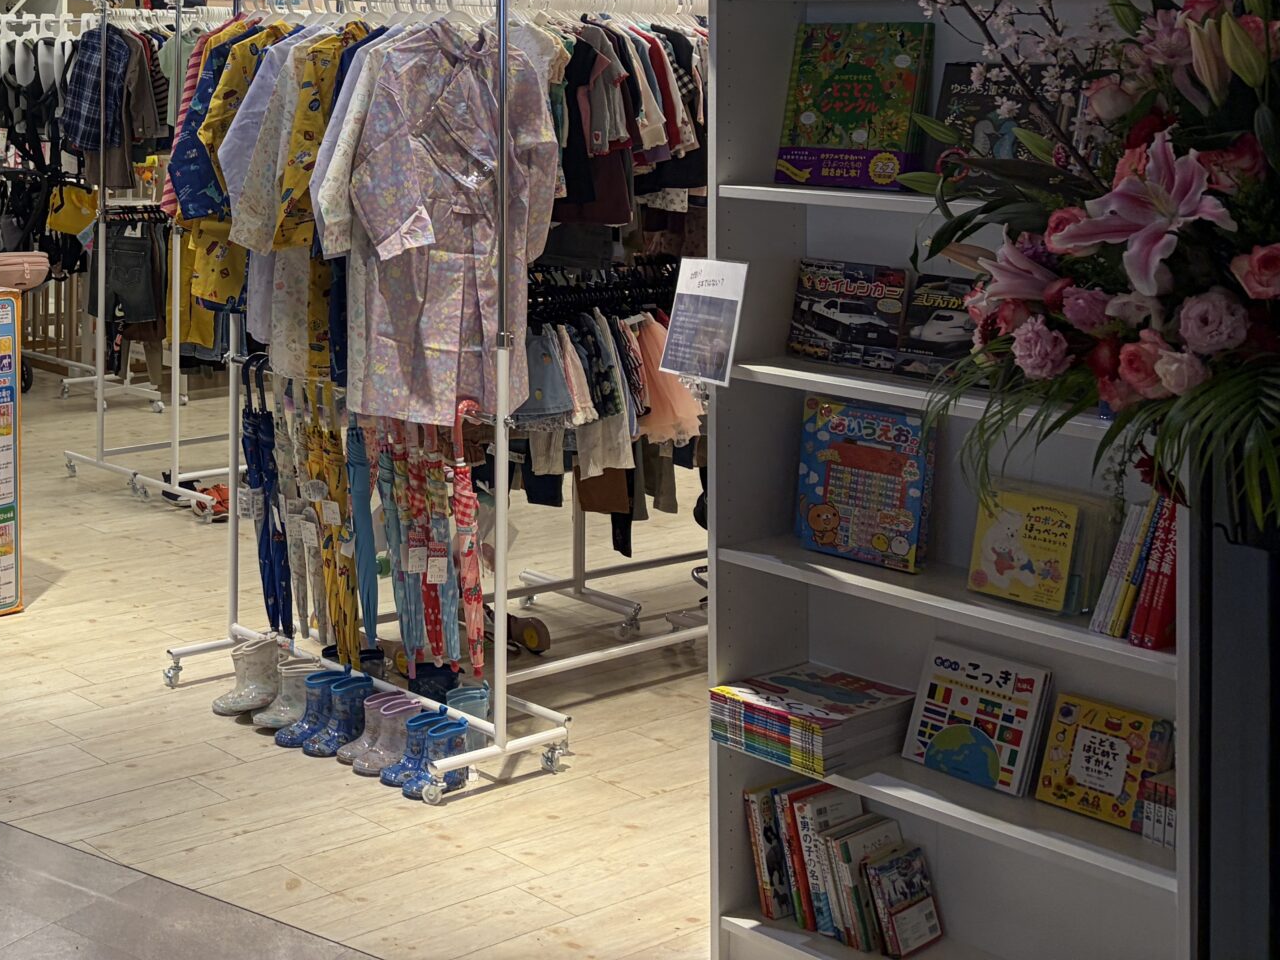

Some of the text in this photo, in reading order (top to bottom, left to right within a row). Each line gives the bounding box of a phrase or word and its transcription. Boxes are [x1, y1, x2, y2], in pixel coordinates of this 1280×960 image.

[818, 277, 904, 299] サイレンカー
[1089, 735, 1117, 751] こども
[1083, 743, 1120, 761] はじめて
[1084, 755, 1113, 771] ずかん
